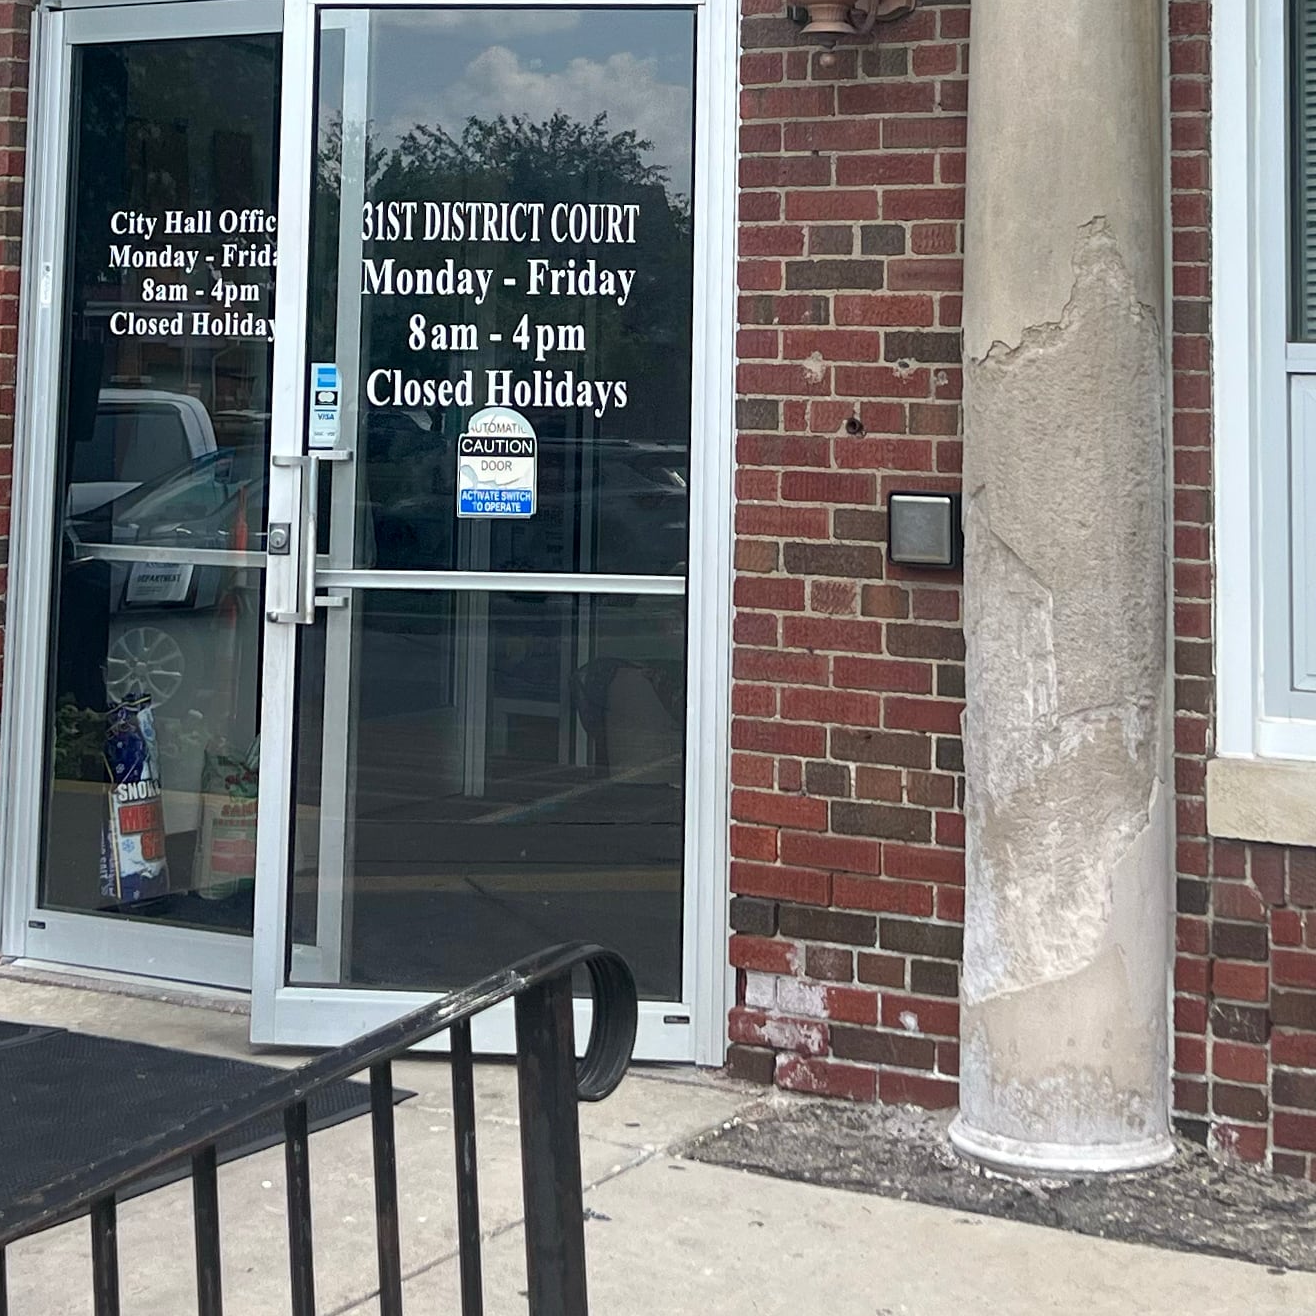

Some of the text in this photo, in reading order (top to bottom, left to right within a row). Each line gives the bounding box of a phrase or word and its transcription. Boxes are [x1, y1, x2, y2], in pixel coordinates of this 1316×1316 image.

[111, 212, 157, 240] City
[165, 211, 211, 234] Hall
[362, 201, 639, 243] 31ST DISTRICT COURT
[109, 245, 198, 273] Monday
[142, 279, 187, 301] 8am
[211, 278, 260, 307] 4pm
[361, 259, 493, 304] Monday
[527, 260, 636, 305] Friday
[110, 312, 183, 335] Closed
[409, 314, 478, 351] 8am
[512, 314, 585, 361] 4pm
[367, 369, 628, 417] Closed Holidays
[461, 439, 533, 453] CAUTION
[481, 460, 512, 471] DOOR
[462, 491, 531, 502] ACTIVATE SWITCH
[472, 502, 521, 512] TO OPERATE
